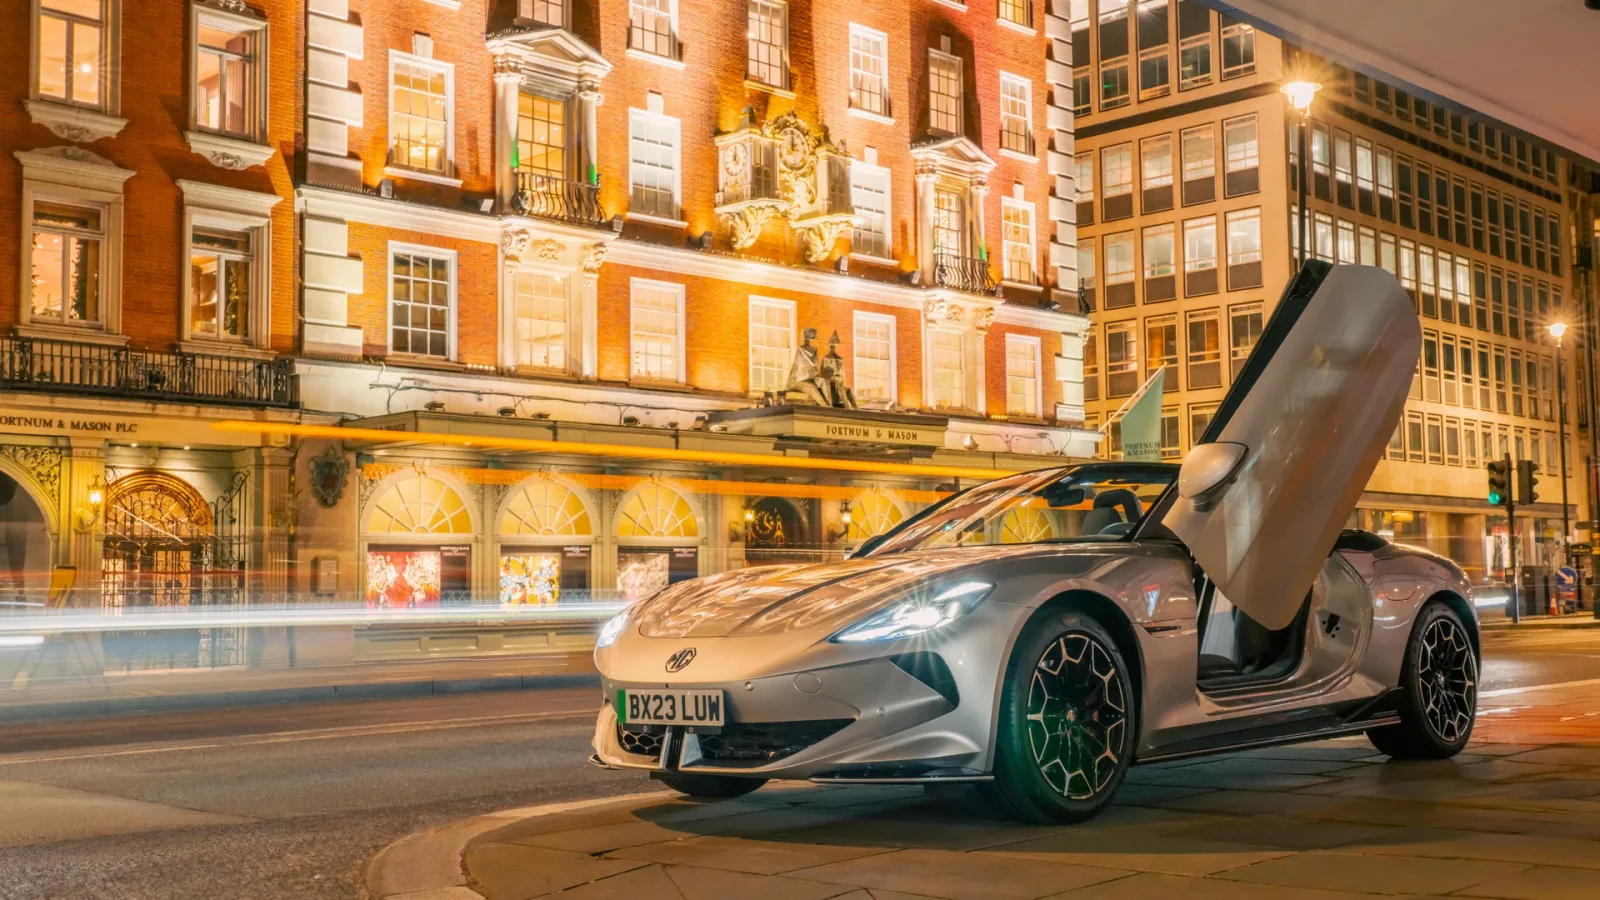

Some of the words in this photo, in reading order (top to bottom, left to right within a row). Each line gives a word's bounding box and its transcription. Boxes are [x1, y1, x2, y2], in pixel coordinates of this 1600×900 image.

[0, 416, 53, 428] ORTNUM
[57, 420, 65, 429] &
[70, 420, 111, 431] MASON
[116, 423, 138, 432] PLC
[826, 425, 870, 437] FORTNUM
[876, 429, 882, 438] &
[888, 430, 918, 440] MASON
[667, 648, 696, 671] MG
[629, 694, 677, 720] BX23
[681, 694, 720, 721] LUW
